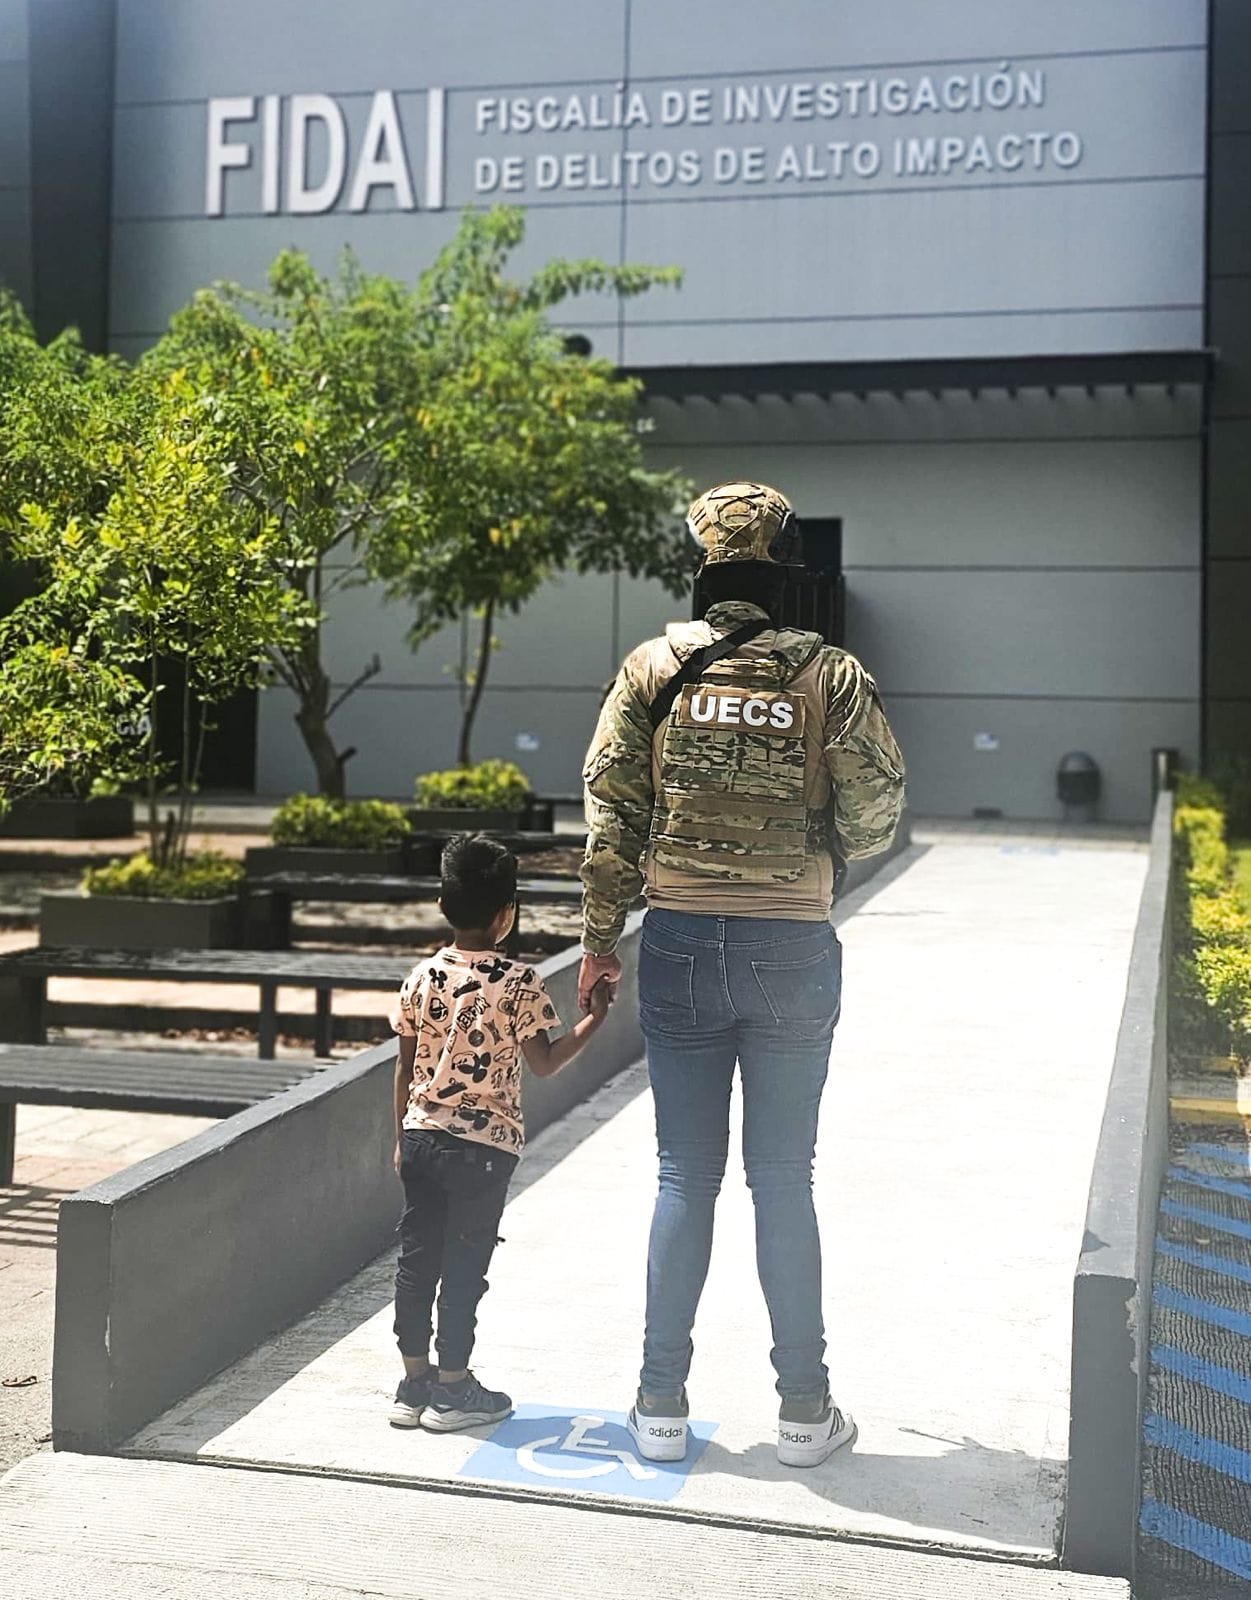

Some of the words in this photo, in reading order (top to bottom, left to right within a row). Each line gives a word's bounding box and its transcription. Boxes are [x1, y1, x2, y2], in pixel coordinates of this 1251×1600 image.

[475, 82, 651, 132] FISCALÍA
[660, 88, 711, 125] DE
[722, 62, 1045, 123] INVESTIGACIÓN
[205, 87, 447, 217] FIDAI
[474, 155, 525, 192] DE
[535, 149, 701, 189] DELITOS
[713, 146, 765, 183] DE
[775, 141, 880, 182] ALTO
[894, 131, 1082, 174] IMPACTO
[690, 694, 794, 729] UECS
[648, 1427, 682, 1437] adidas
